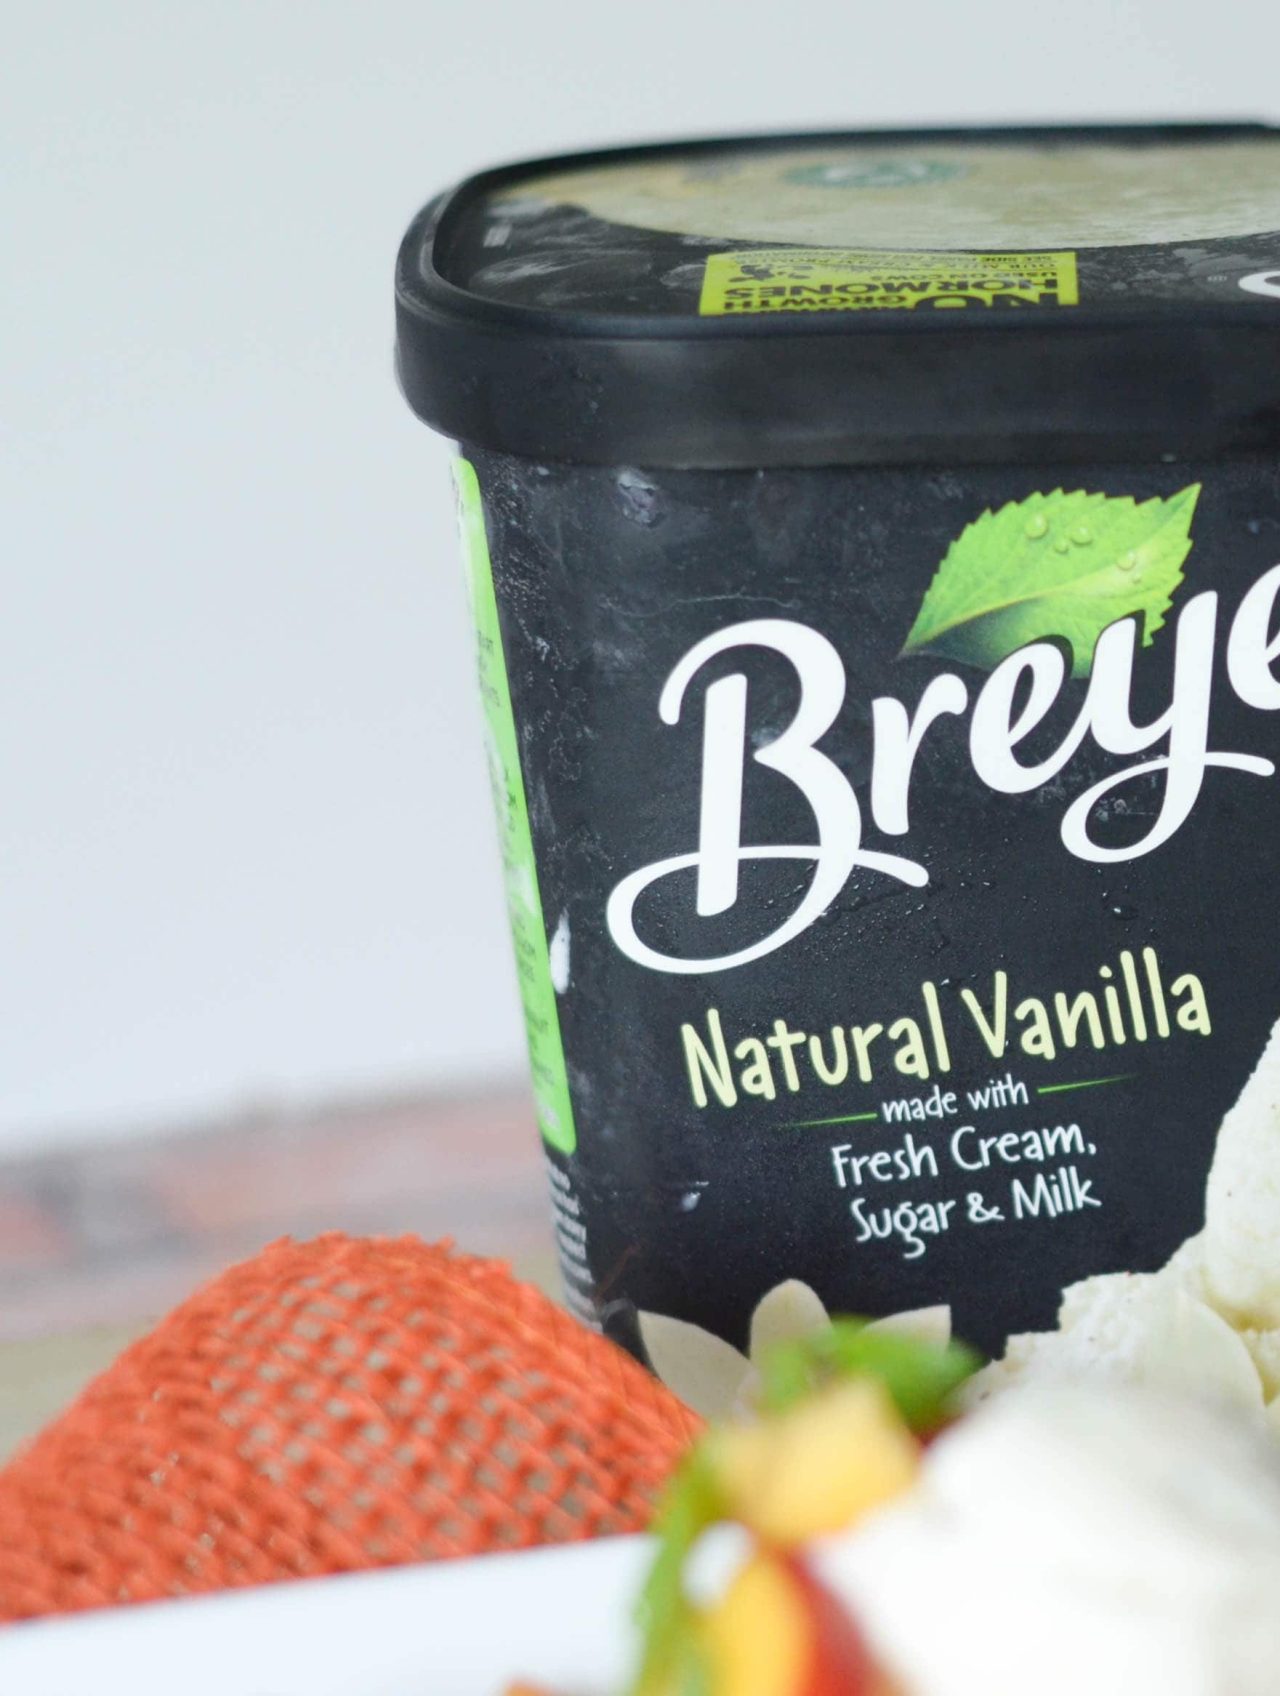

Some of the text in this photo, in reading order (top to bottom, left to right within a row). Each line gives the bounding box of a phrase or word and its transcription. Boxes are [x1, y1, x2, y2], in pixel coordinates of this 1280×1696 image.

[724, 279, 1058, 299] HORMONES
[724, 295, 908, 310] GROWTH
[681, 980, 950, 1108] Natural
[961, 946, 1211, 1060] Vanilla
[881, 1072, 1030, 1124] made with
[831, 1124, 1098, 1188] Fresh Cream,
[850, 1165, 1102, 1260] Sugar & Milk
